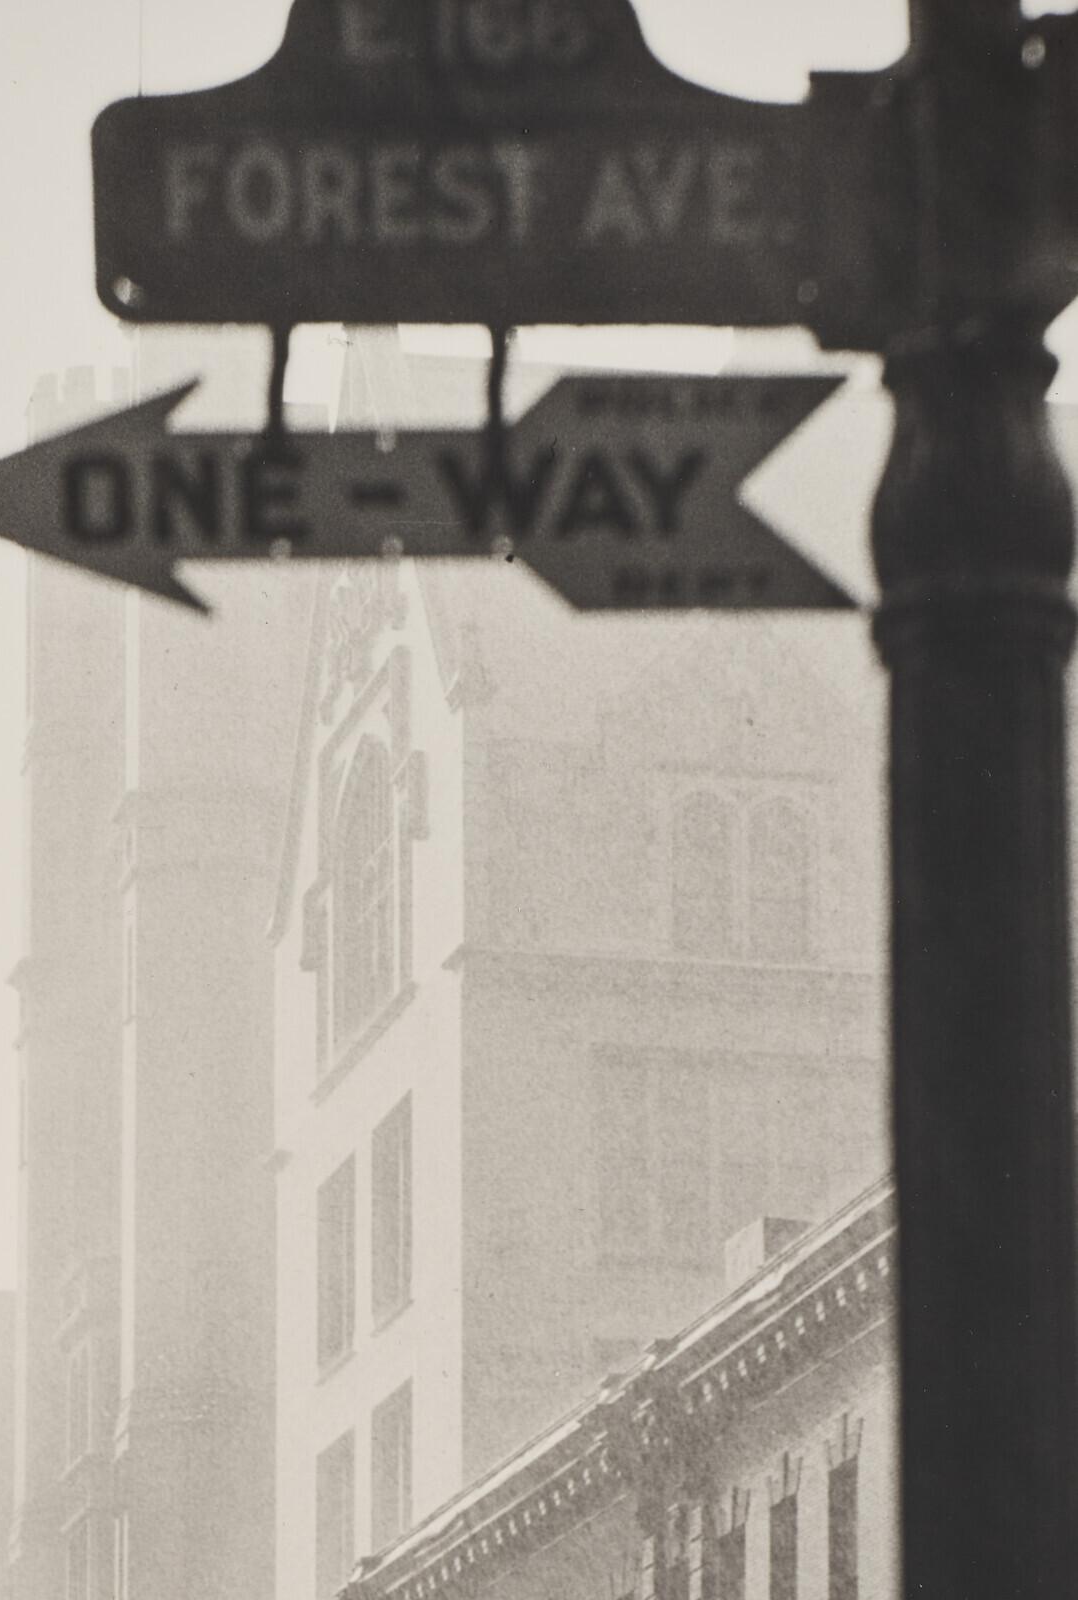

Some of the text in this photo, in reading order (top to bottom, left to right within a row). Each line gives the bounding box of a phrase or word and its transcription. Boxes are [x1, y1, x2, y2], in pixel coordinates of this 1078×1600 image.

[162, 138, 550, 249] FOREST
[60, 450, 310, 546] ONE
[433, 448, 706, 543] WAY
